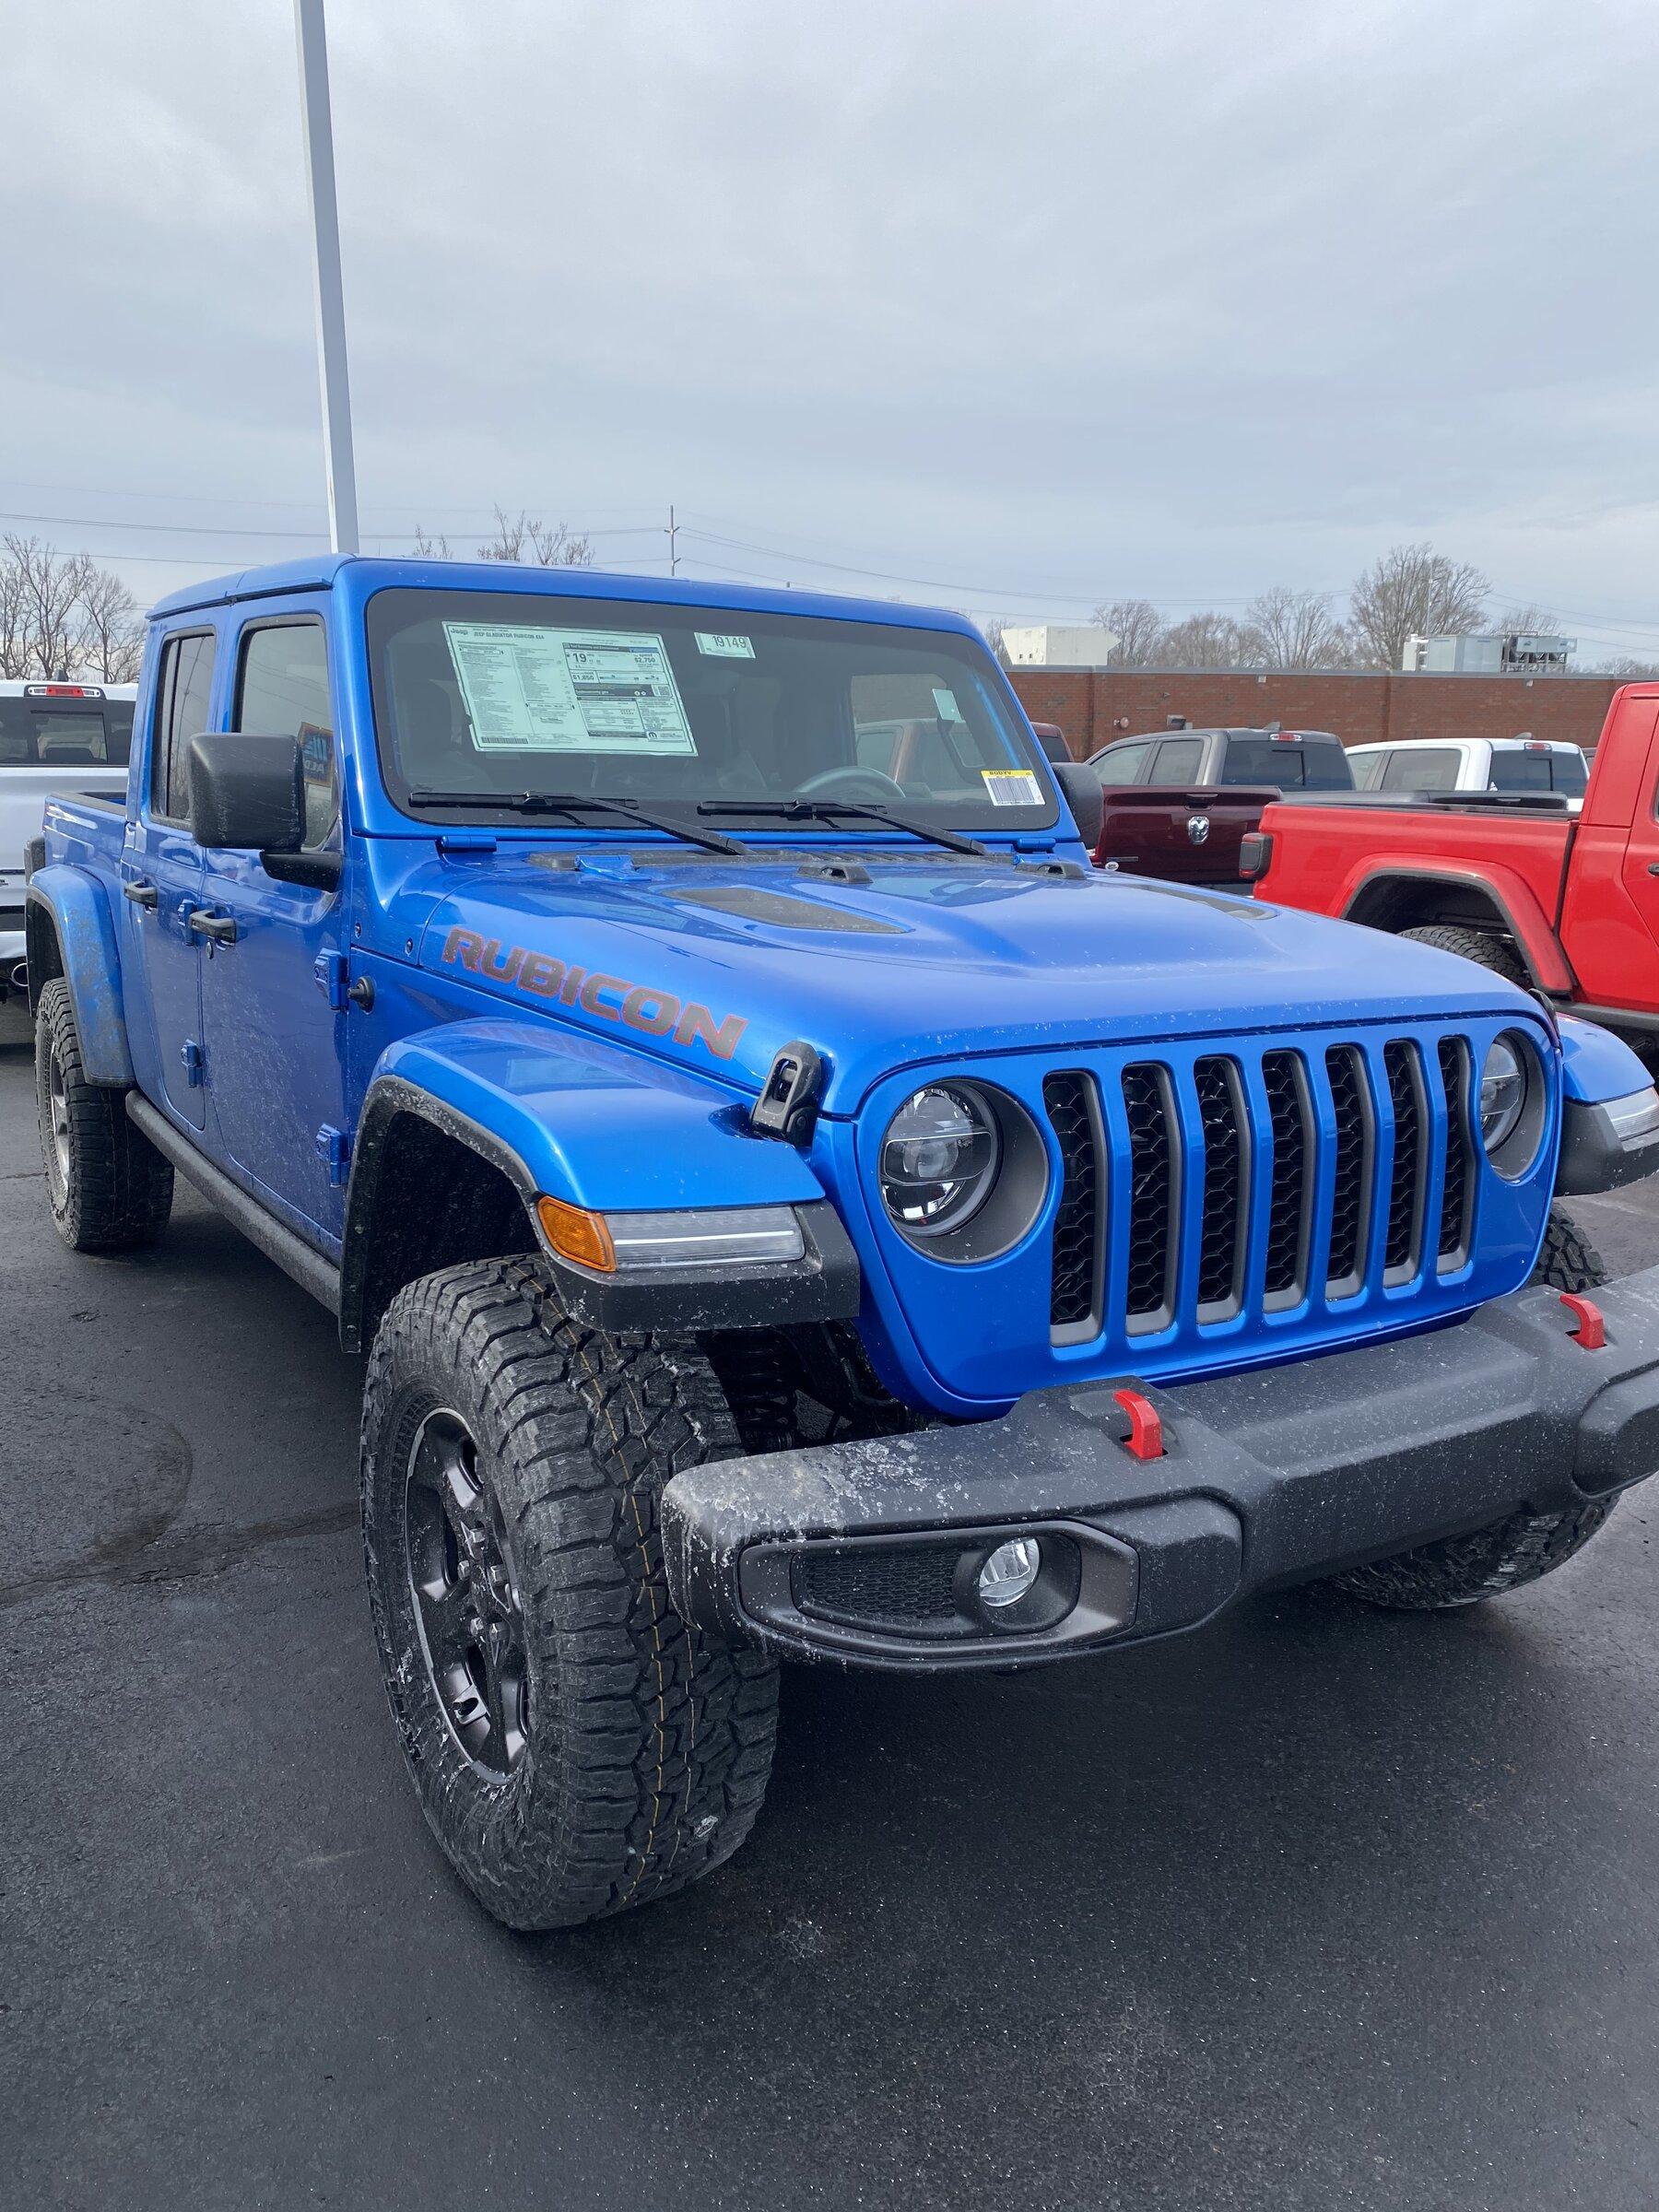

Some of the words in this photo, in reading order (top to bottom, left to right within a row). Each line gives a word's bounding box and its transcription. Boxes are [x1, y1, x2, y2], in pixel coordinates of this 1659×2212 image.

[712, 636, 747, 648] 19149
[572, 653, 587, 663] 19
[442, 926, 748, 1060] RUBICON
